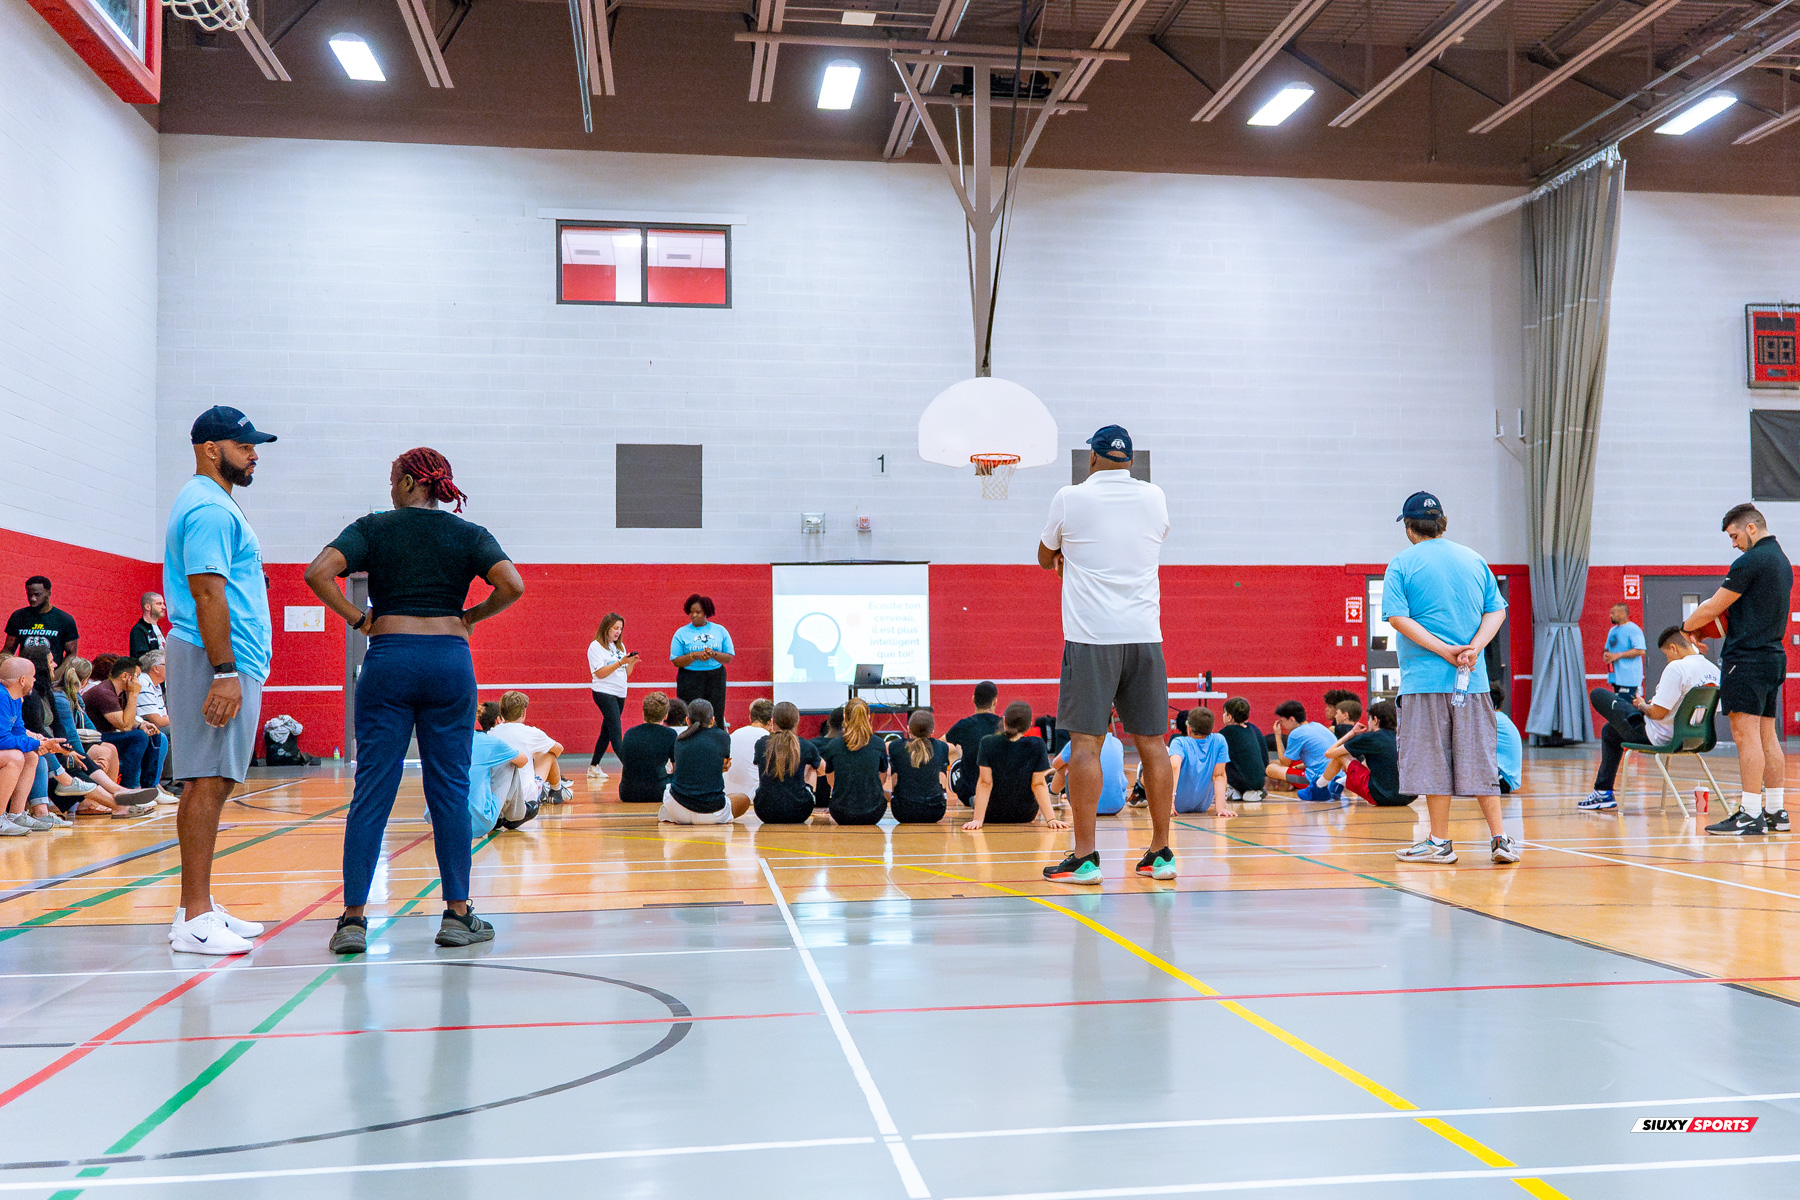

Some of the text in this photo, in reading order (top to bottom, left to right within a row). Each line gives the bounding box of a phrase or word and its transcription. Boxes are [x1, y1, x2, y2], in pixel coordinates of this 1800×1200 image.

[877, 453, 885, 473] 1
[905, 602, 921, 610] ton
[897, 626, 918, 636] plus
[870, 638, 920, 647] intelligent
[877, 650, 896, 659] que
